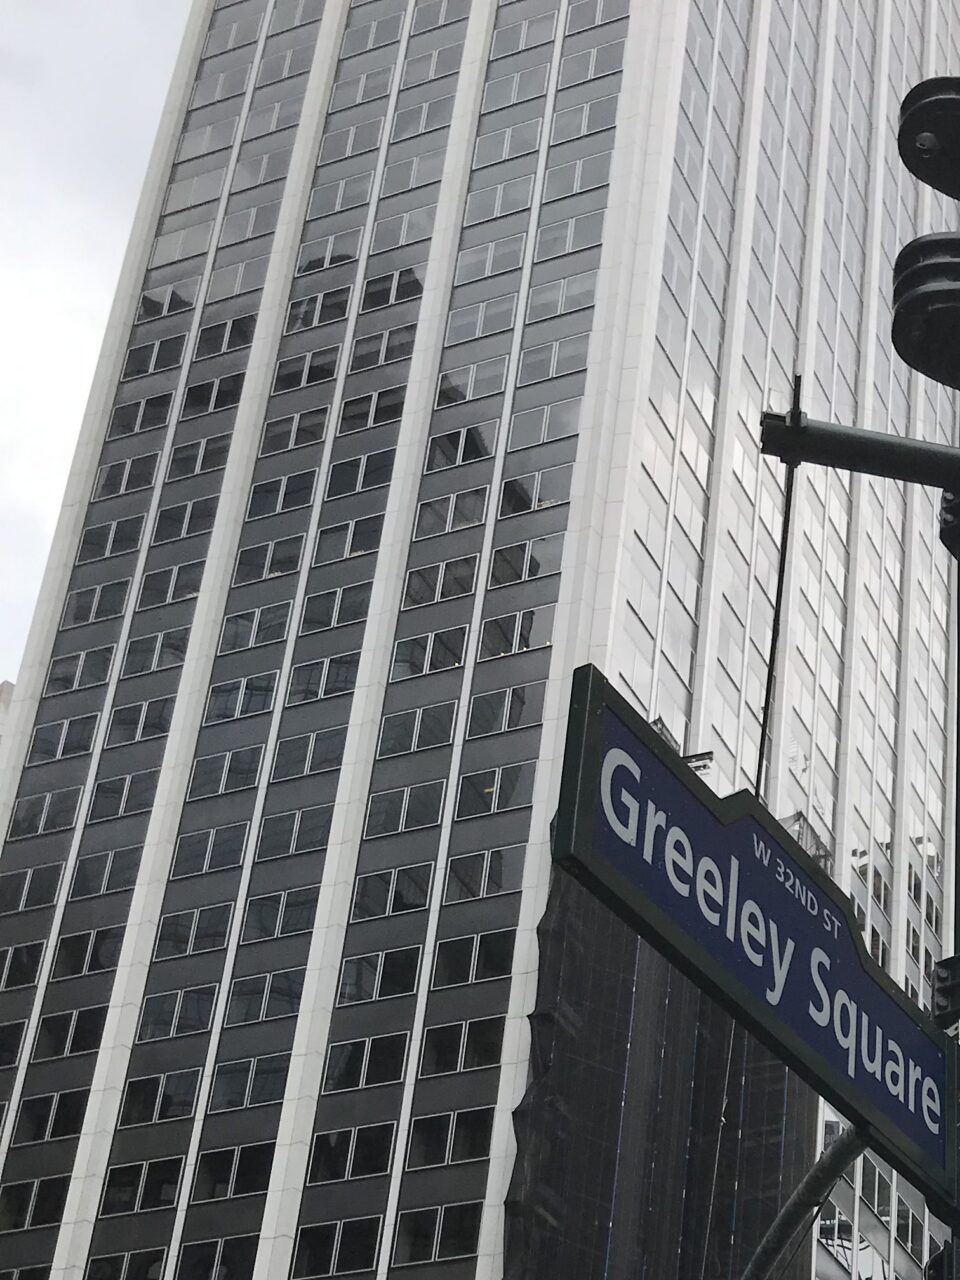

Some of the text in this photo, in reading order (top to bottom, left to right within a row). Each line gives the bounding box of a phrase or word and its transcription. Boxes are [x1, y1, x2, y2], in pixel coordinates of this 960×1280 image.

[600, 747, 942, 1135] Greeley Square
[752, 832, 842, 940] W 32ND ST
